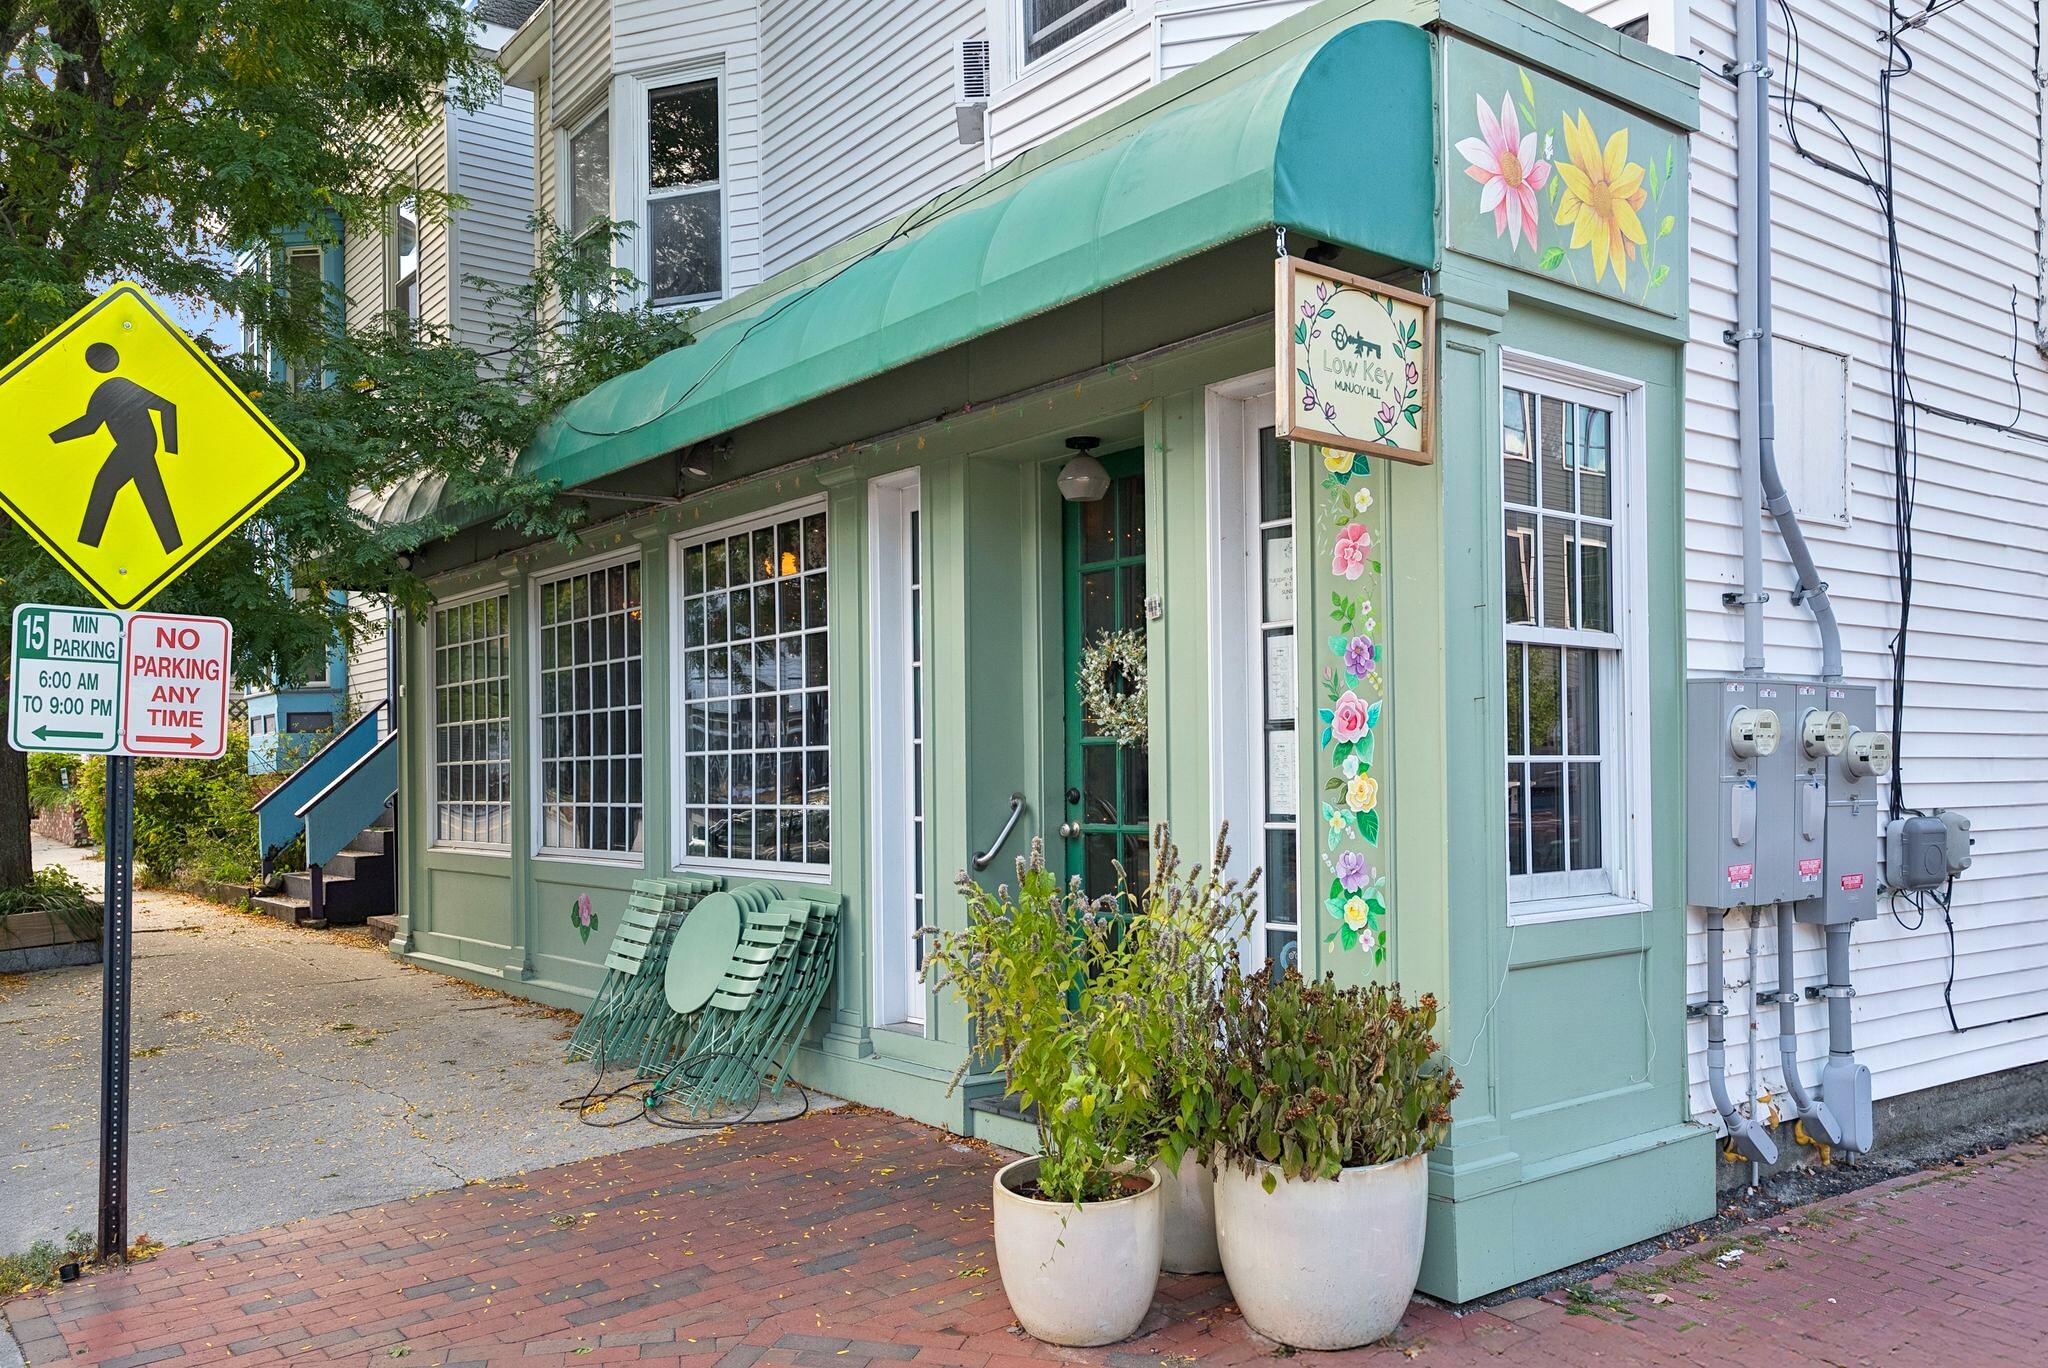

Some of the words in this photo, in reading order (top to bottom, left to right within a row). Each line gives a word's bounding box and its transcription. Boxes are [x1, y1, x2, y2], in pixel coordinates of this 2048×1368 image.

[1335, 379, 1366, 396] MUNJOY
[1366, 387, 1381, 400] HILL
[22, 614, 45, 650] 15
[72, 616, 98, 634] MIN
[53, 638, 115, 659] PARKING
[156, 627, 200, 650] NO
[133, 655, 219, 681] PARKING
[39, 670, 71, 689] 6:00
[77, 673, 99, 691] AM
[23, 695, 42, 713] TO
[50, 697, 84, 715] 9:00
[91, 699, 112, 716] PM
[151, 686, 200, 704] ANY
[147, 709, 203, 728] TIME
